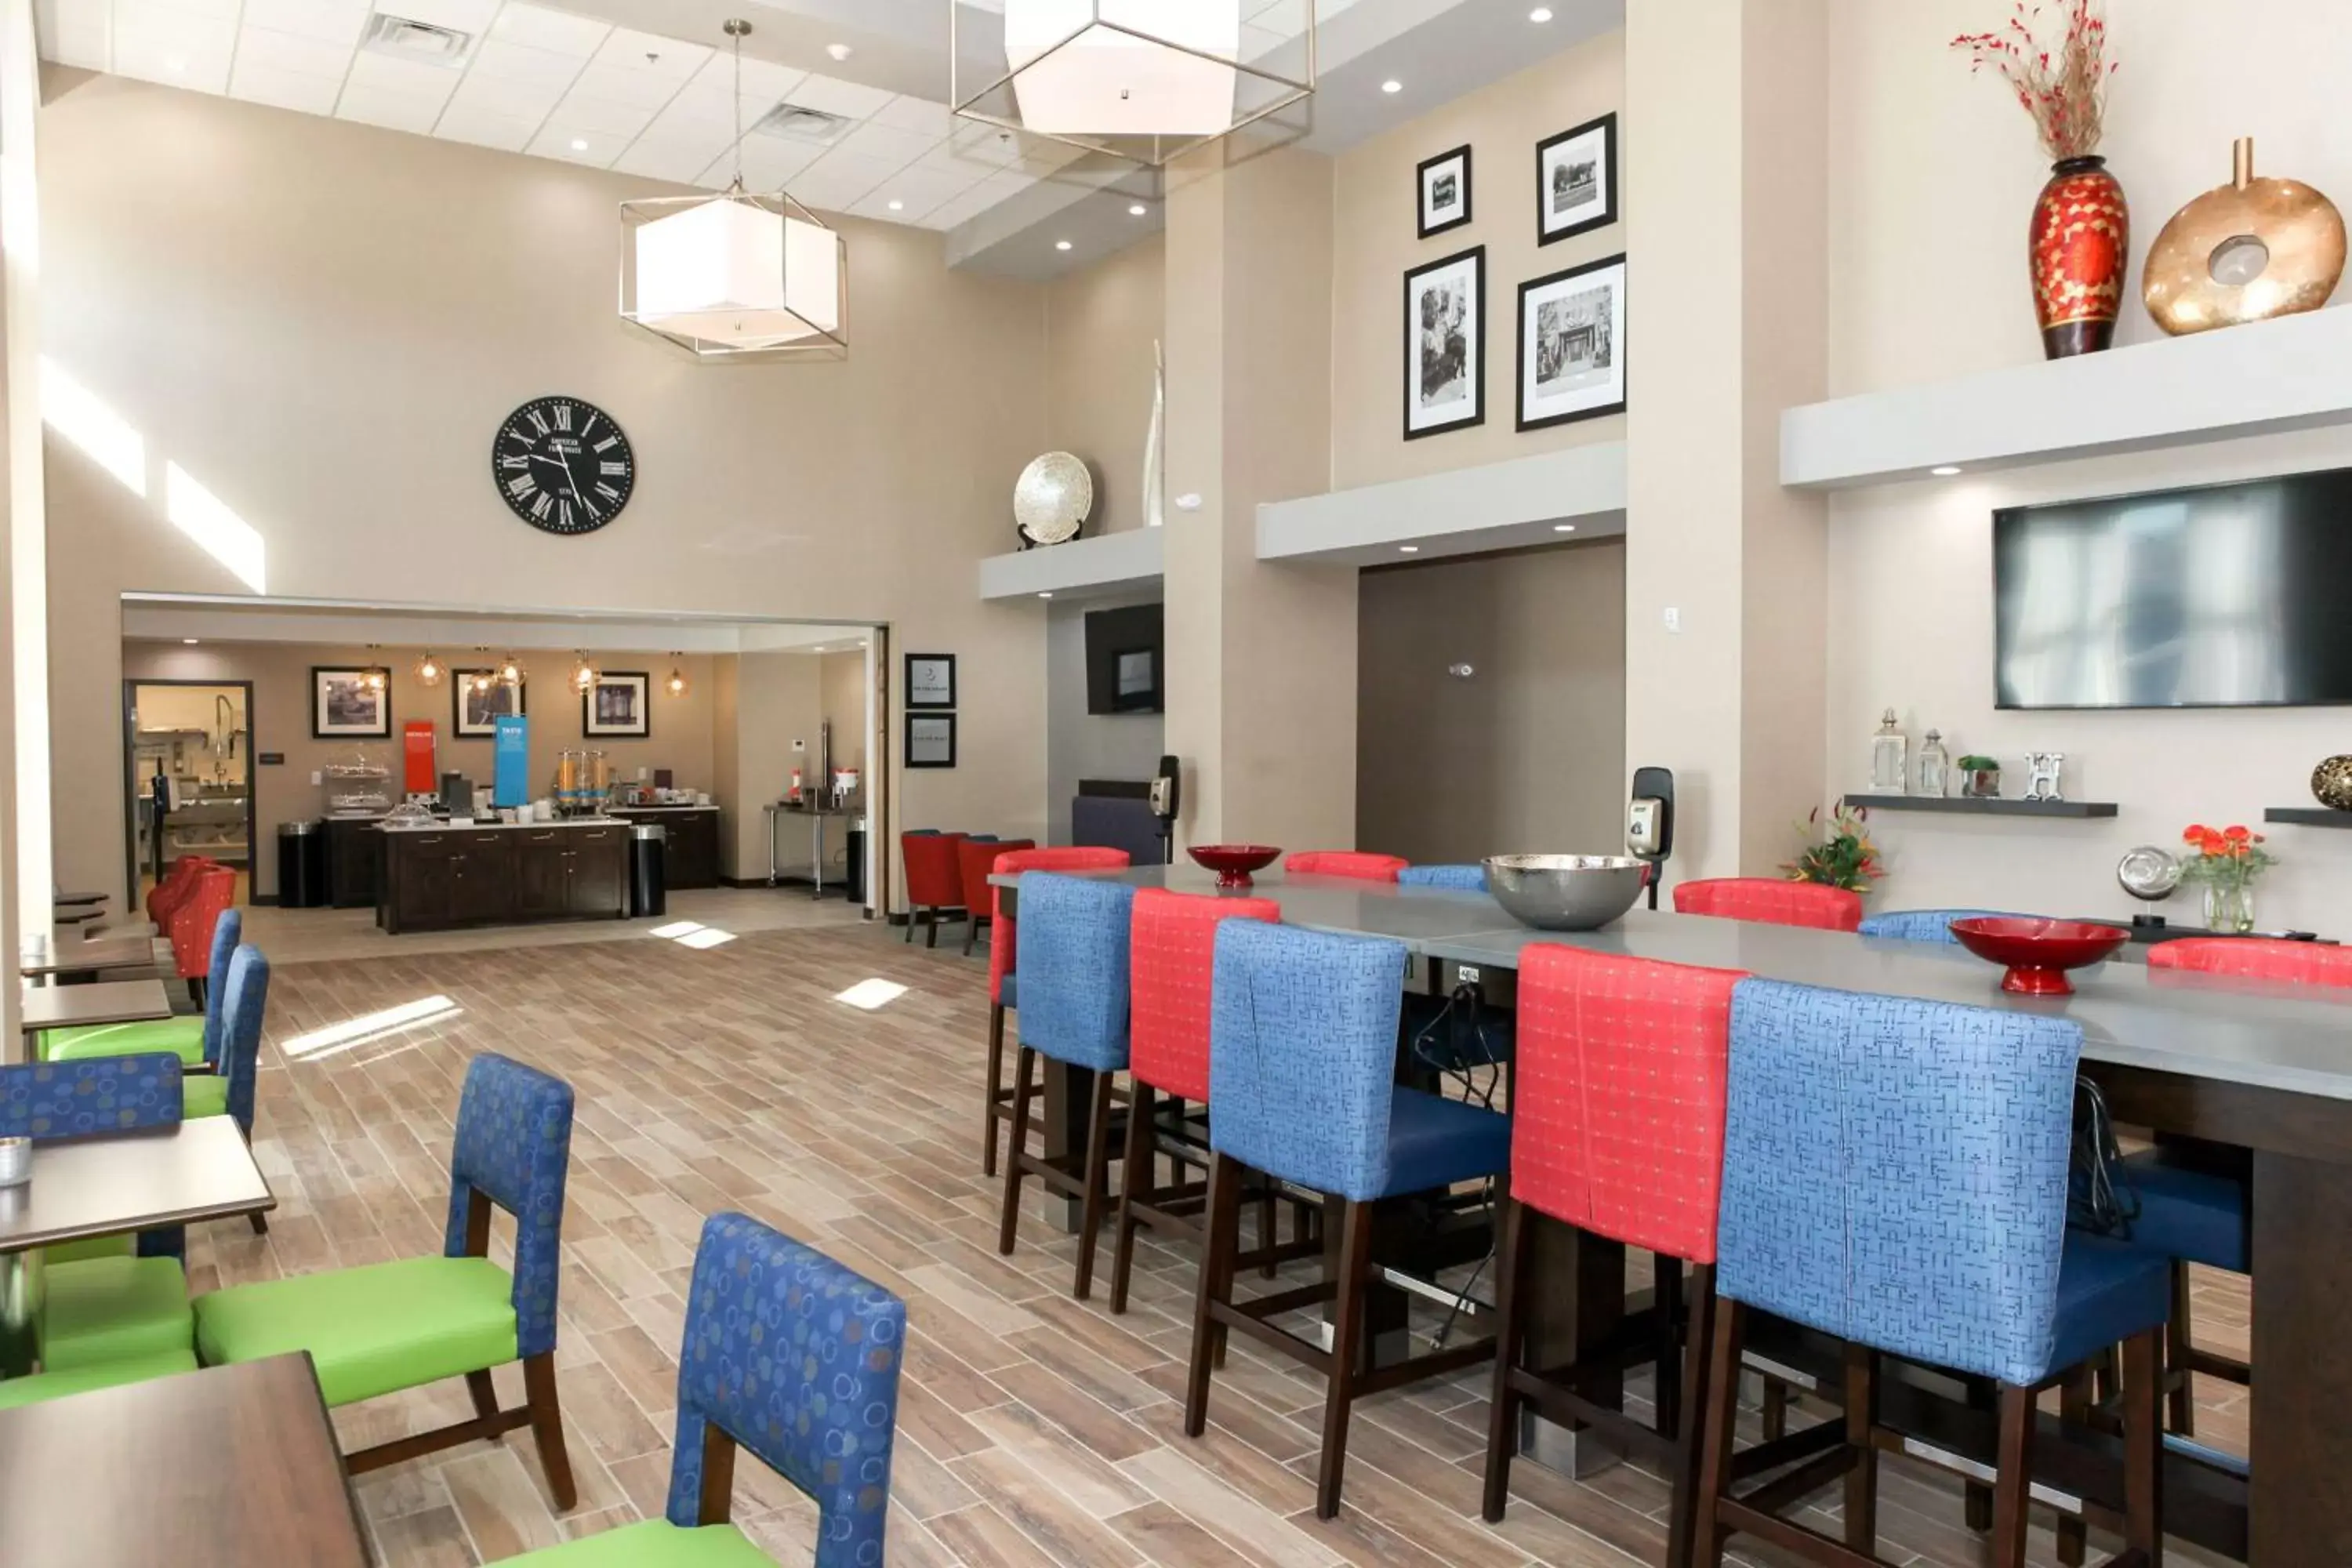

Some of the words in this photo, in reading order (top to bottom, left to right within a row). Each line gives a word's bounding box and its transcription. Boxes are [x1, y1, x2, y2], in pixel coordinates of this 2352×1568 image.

[527, 408, 551, 438] XI
[553, 405, 572, 431] XII
[580, 414, 597, 437] I
[510, 426, 536, 450] X
[593, 435, 618, 454] II
[503, 454, 529, 468] IX
[600, 460, 626, 475] III
[508, 474, 538, 501] VIII
[531, 490, 554, 521] VII
[559, 499, 575, 525] VI
[583, 495, 601, 521] V
[2024, 752, 2066, 801] H
